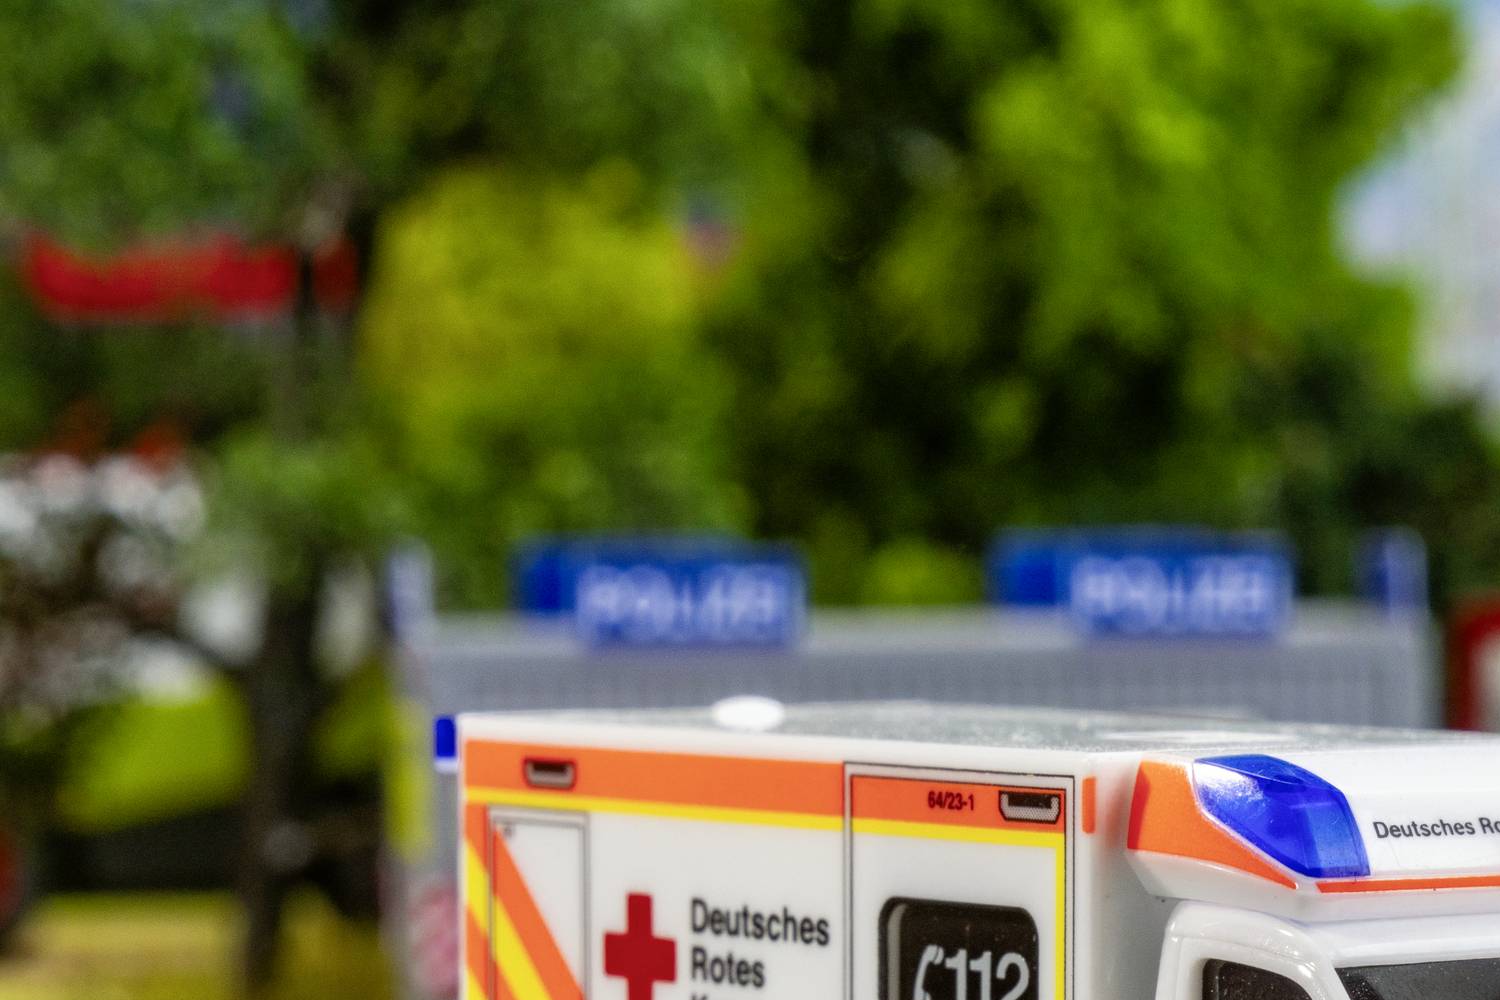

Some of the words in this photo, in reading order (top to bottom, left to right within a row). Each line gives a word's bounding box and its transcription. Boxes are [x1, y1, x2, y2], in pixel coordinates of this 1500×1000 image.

[927, 790, 975, 811] 64/23-1
[1373, 818, 1476, 839] Deutsches
[692, 897, 829, 946] Deutsches
[692, 945, 765, 988] Rotes
